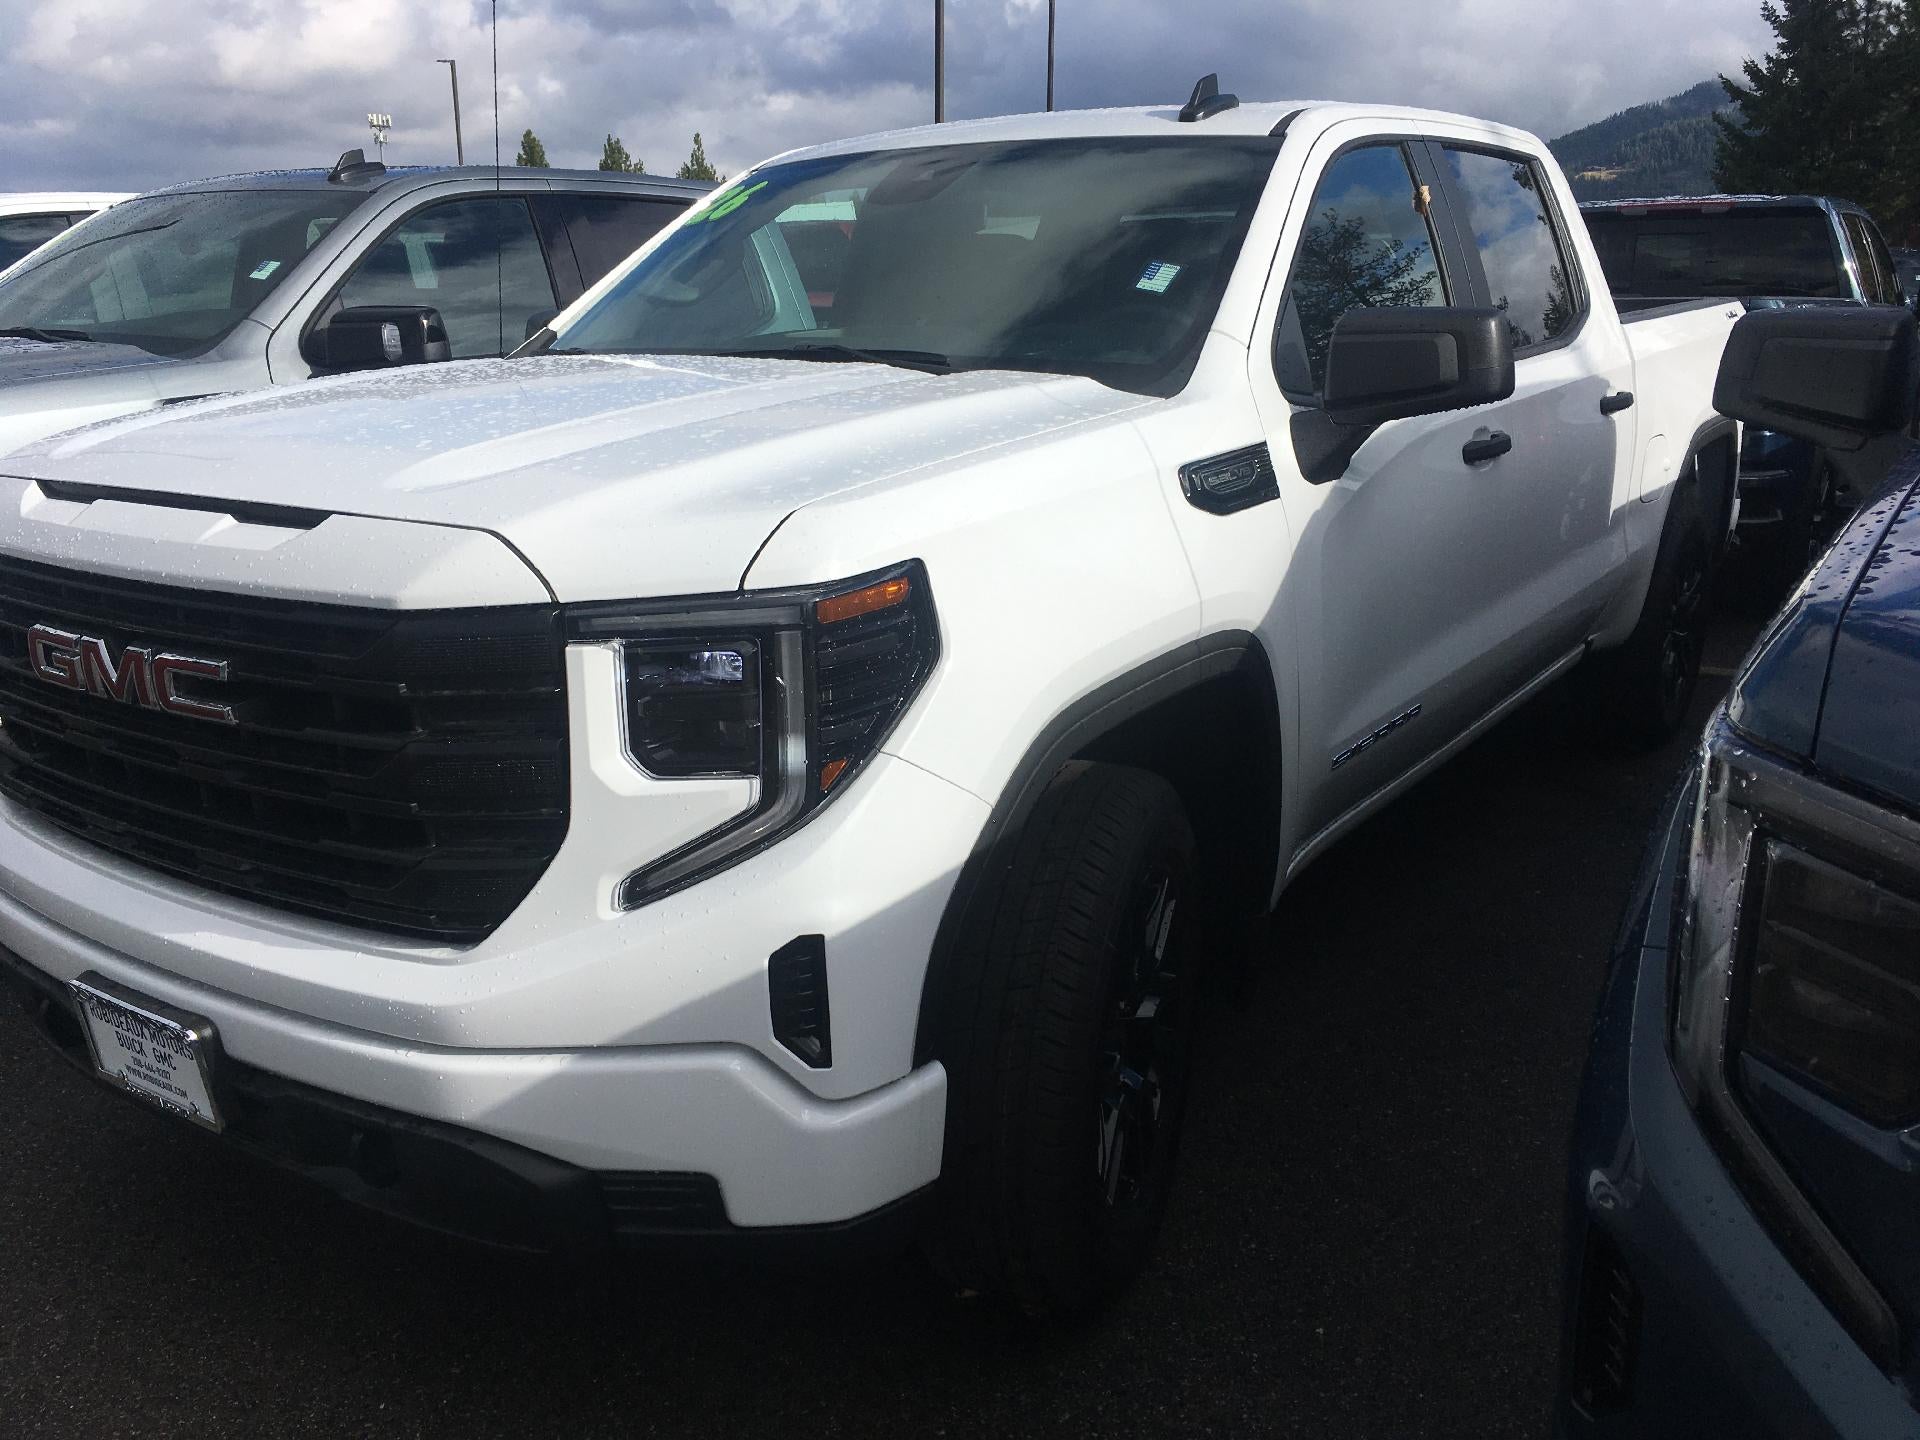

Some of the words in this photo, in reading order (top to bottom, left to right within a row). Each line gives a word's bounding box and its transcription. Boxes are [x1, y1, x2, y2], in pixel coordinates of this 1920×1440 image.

[28, 623, 239, 726] GMC
[115, 1030, 148, 1057] BUICK
[153, 1048, 177, 1071] GMC
